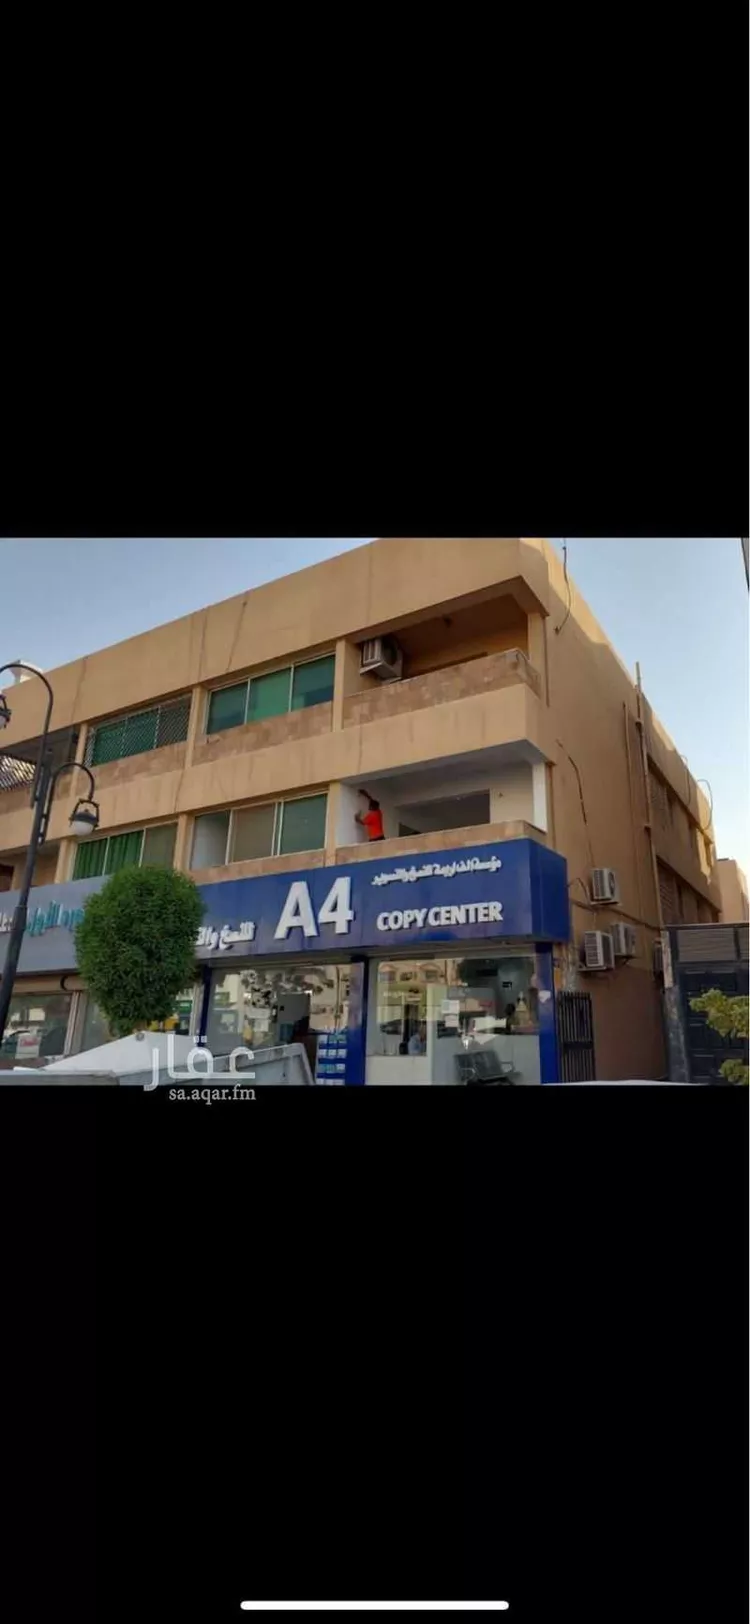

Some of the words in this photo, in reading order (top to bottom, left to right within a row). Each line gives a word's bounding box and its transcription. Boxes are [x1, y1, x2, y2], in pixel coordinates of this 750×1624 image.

[274, 876, 354, 939] A4
[376, 908, 428, 931] COPY
[428, 901, 503, 926] CENTER
